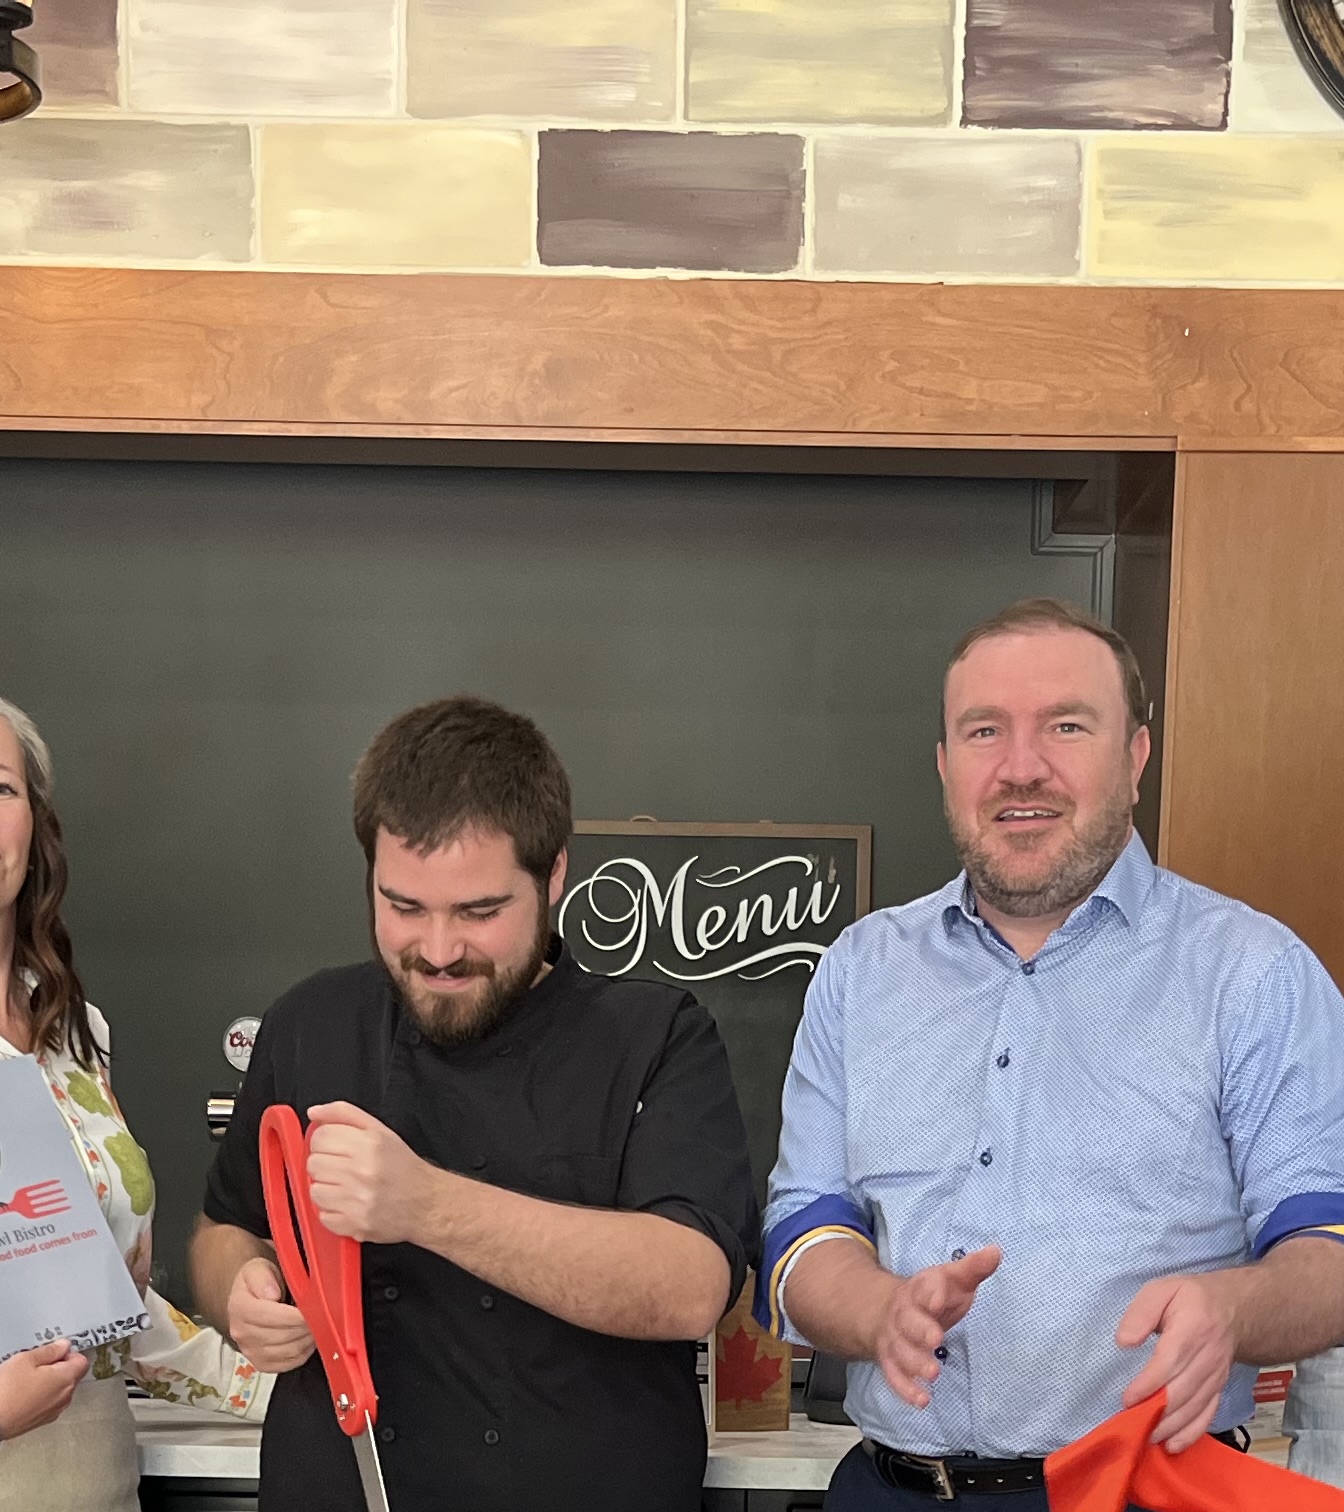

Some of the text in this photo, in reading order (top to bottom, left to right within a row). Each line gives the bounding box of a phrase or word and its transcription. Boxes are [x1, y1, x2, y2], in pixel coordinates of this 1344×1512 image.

[558, 856, 841, 977] Menu
[12, 1223, 55, 1242] Bistro
[13, 1243, 37, 1257] food
[38, 1236, 71, 1250] comes
[71, 1228, 97, 1240] from
